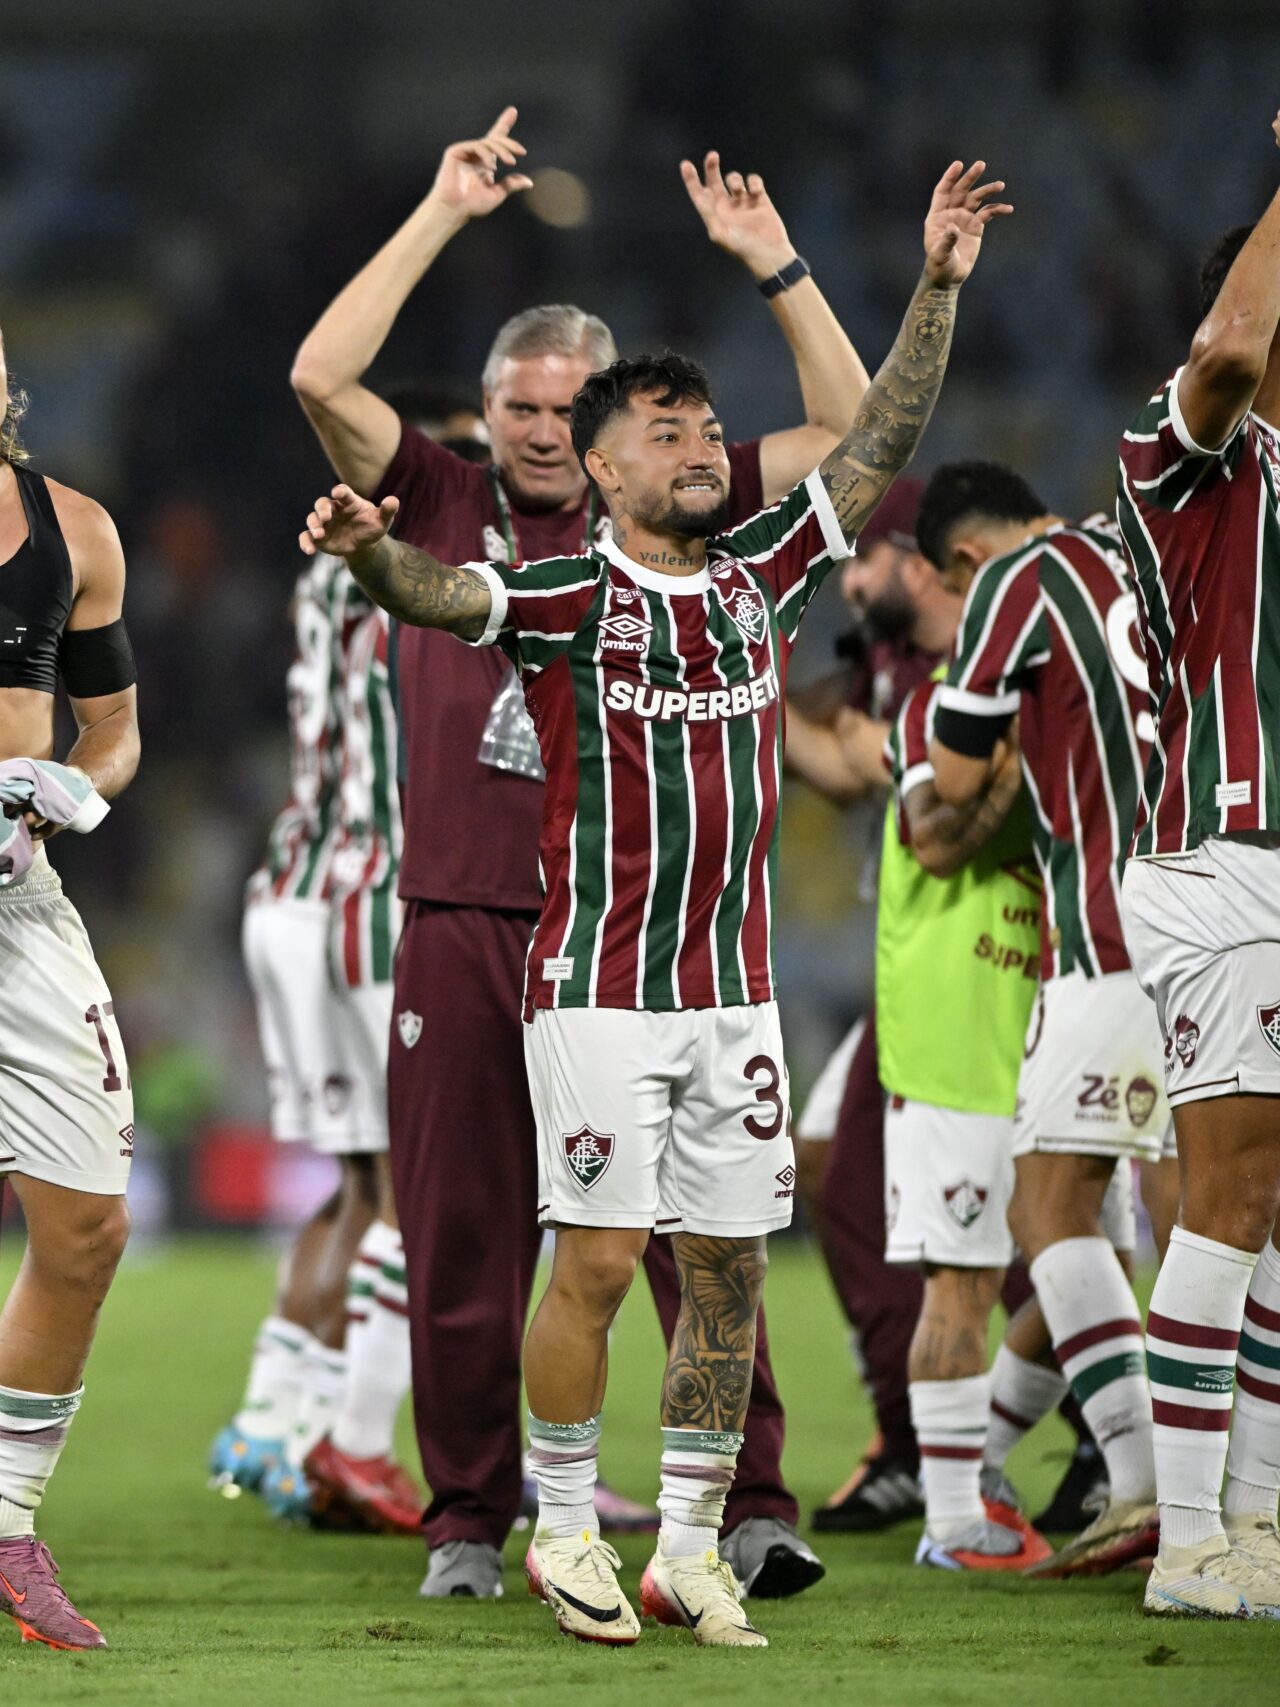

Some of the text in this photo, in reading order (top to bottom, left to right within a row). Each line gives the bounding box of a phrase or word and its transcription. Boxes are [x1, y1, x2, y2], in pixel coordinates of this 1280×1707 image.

[600, 638, 645, 651] umbro
[606, 671, 778, 721] SUPERBET
[743, 1054, 791, 1140] 3
[1078, 1075, 1120, 1109] Zé
